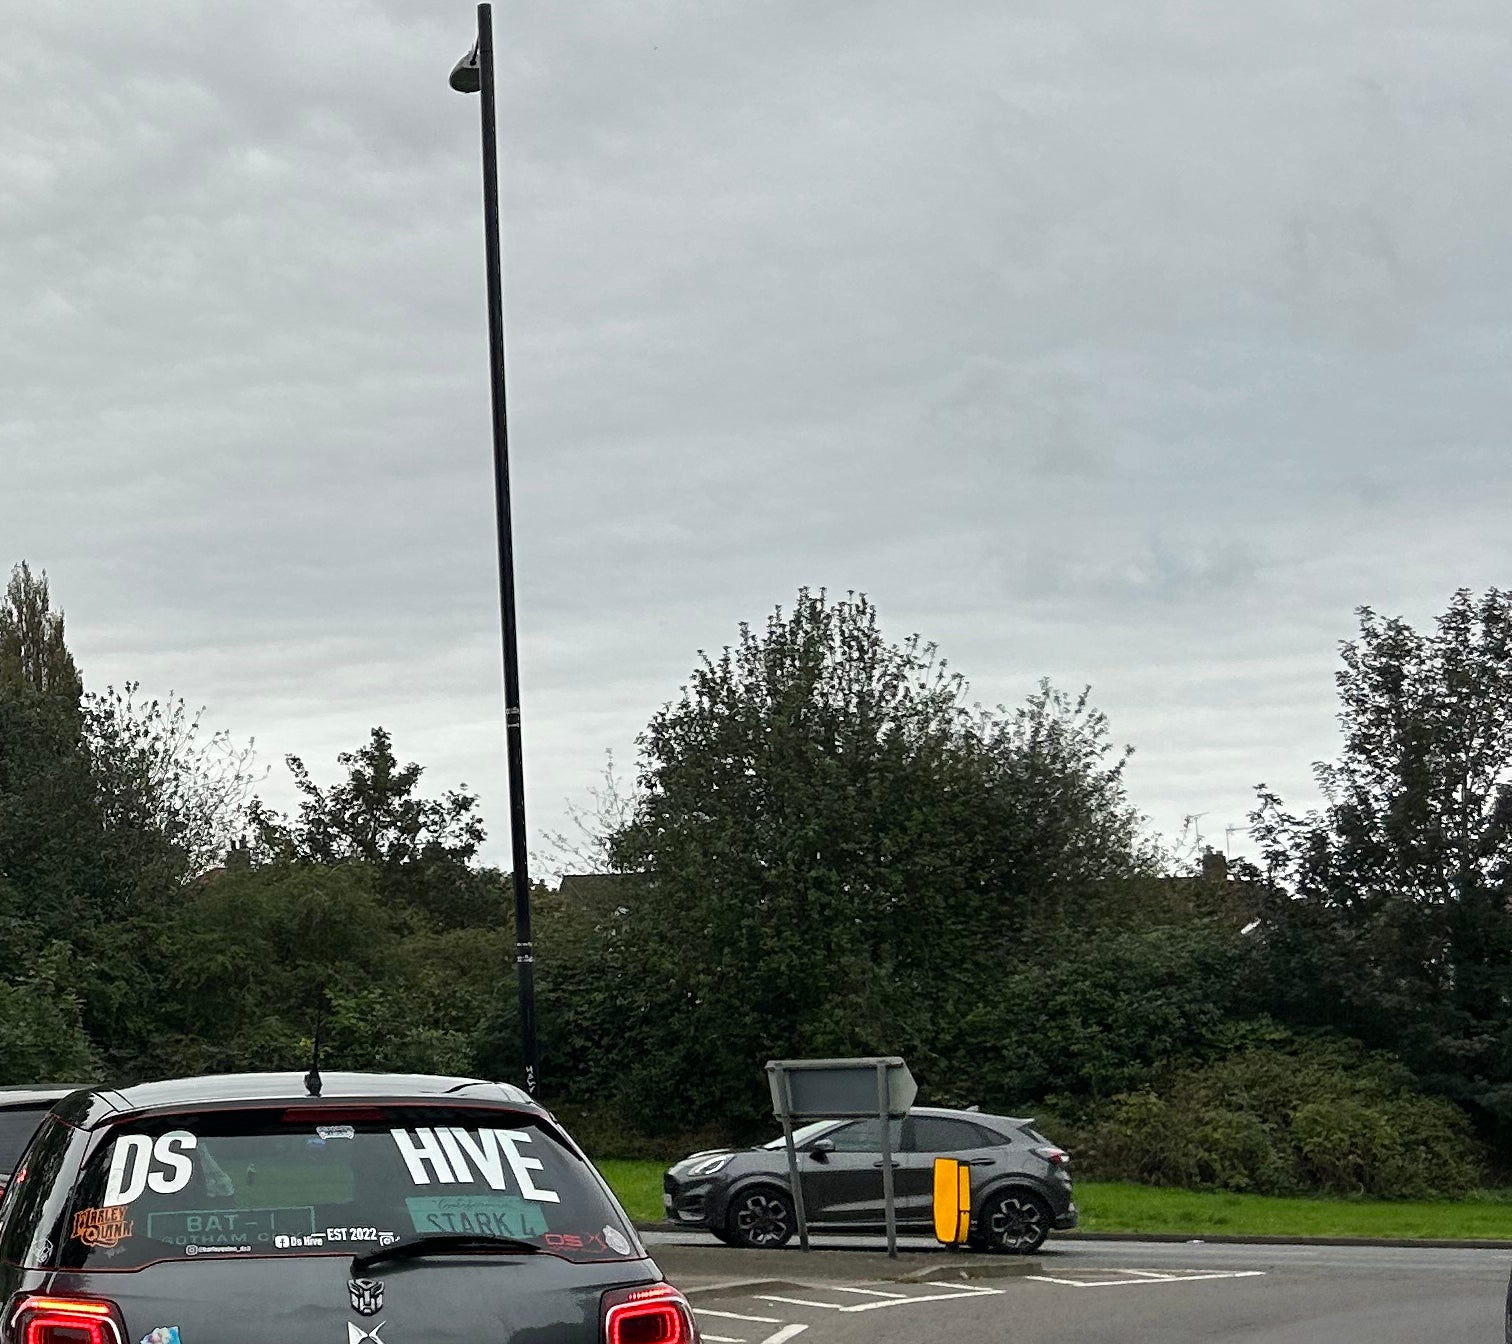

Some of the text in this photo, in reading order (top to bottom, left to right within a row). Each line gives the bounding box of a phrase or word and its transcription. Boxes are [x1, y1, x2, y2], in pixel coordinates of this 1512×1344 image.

[103, 1127, 560, 1207] DS HIVE
[327, 1227, 378, 1241] EST 2022
[427, 1213, 516, 1238] STARK
